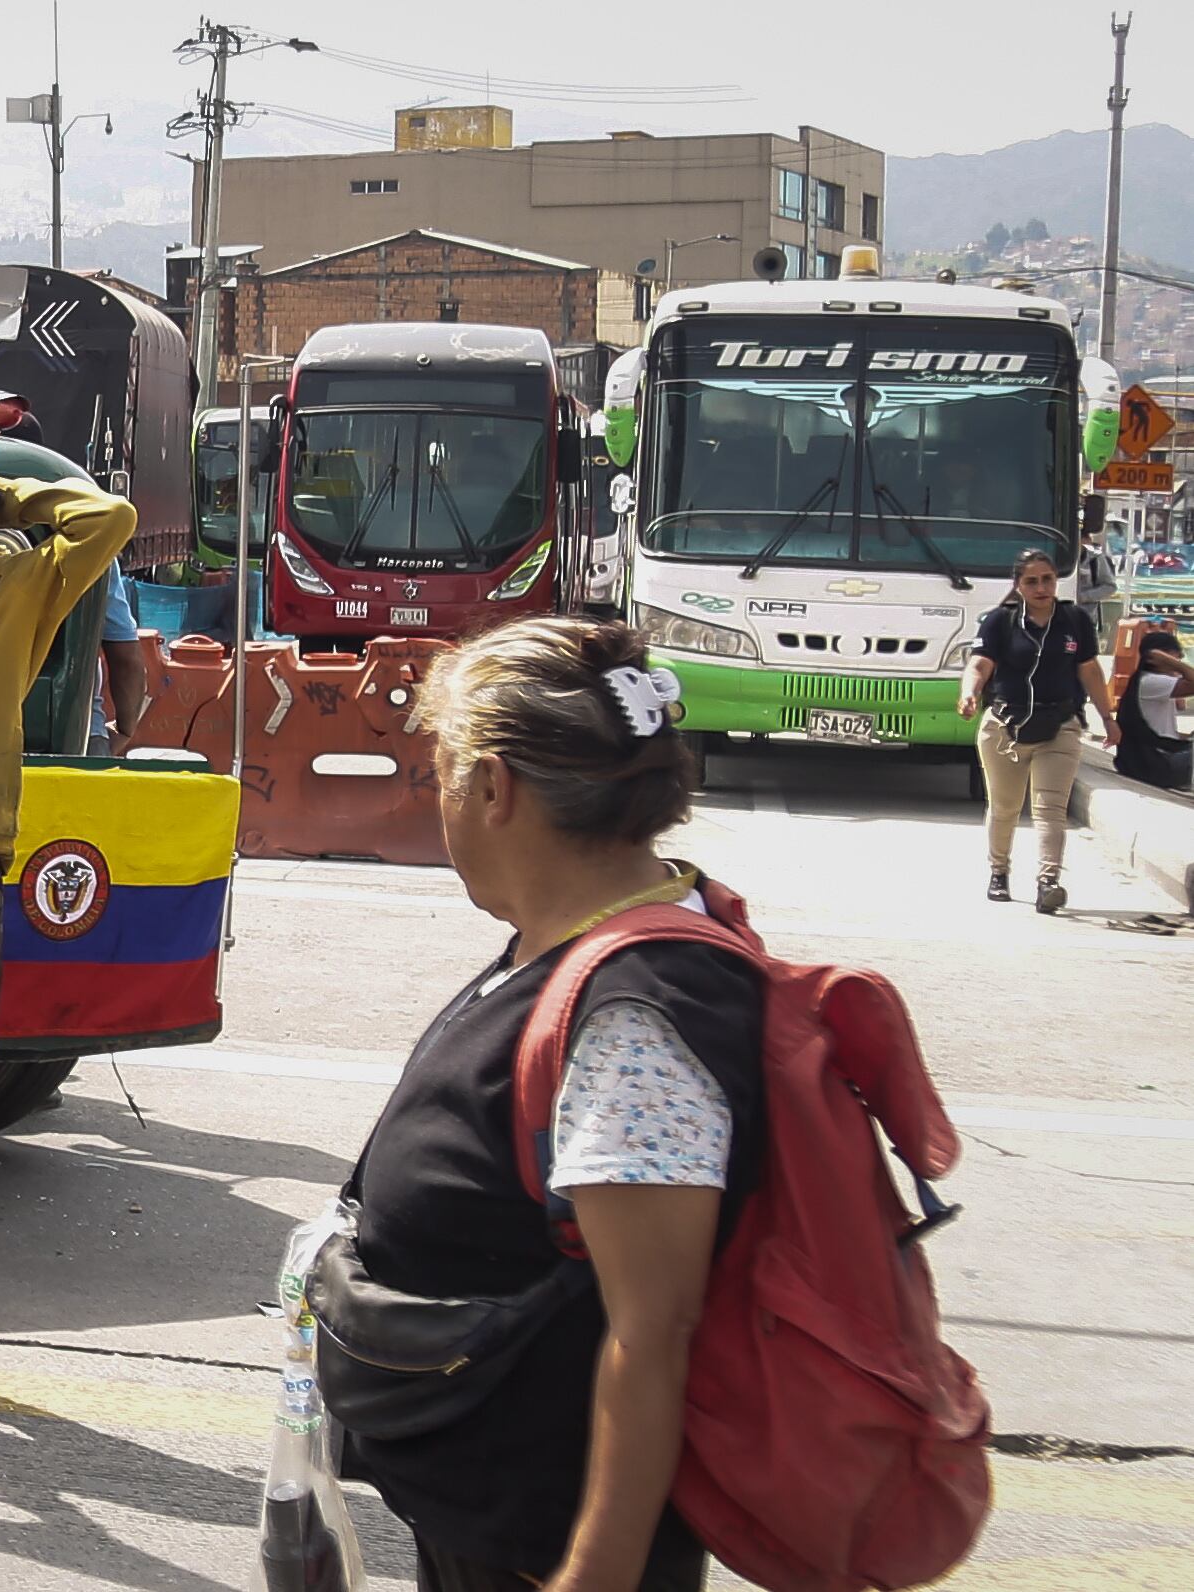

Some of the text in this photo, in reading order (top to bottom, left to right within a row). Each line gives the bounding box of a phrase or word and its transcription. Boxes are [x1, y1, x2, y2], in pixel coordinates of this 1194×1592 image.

[1117, 468, 1148, 484] 200
[1153, 472, 1169, 486] m
[336, 601, 368, 616] U1044
[748, 600, 807, 615] NPR
